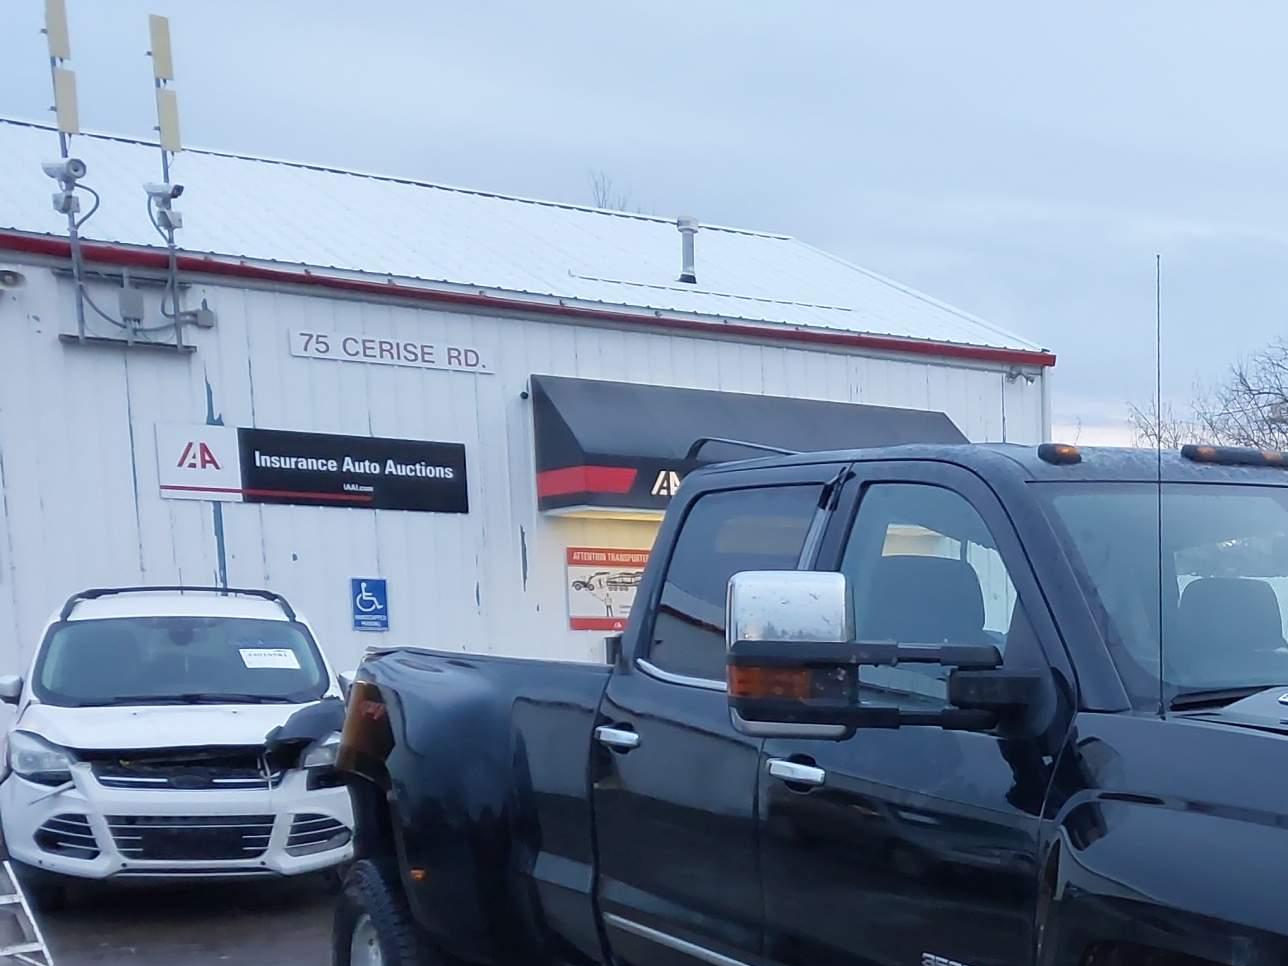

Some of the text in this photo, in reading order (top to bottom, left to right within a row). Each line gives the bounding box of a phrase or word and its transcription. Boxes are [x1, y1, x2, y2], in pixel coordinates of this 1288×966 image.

[299, 332, 486, 369] 75 CERISE RD.
[177, 441, 221, 470] IAA
[255, 450, 454, 479] Insurance Auto Auctions
[572, 551, 649, 563] ATTENTION TRANSPORTE
